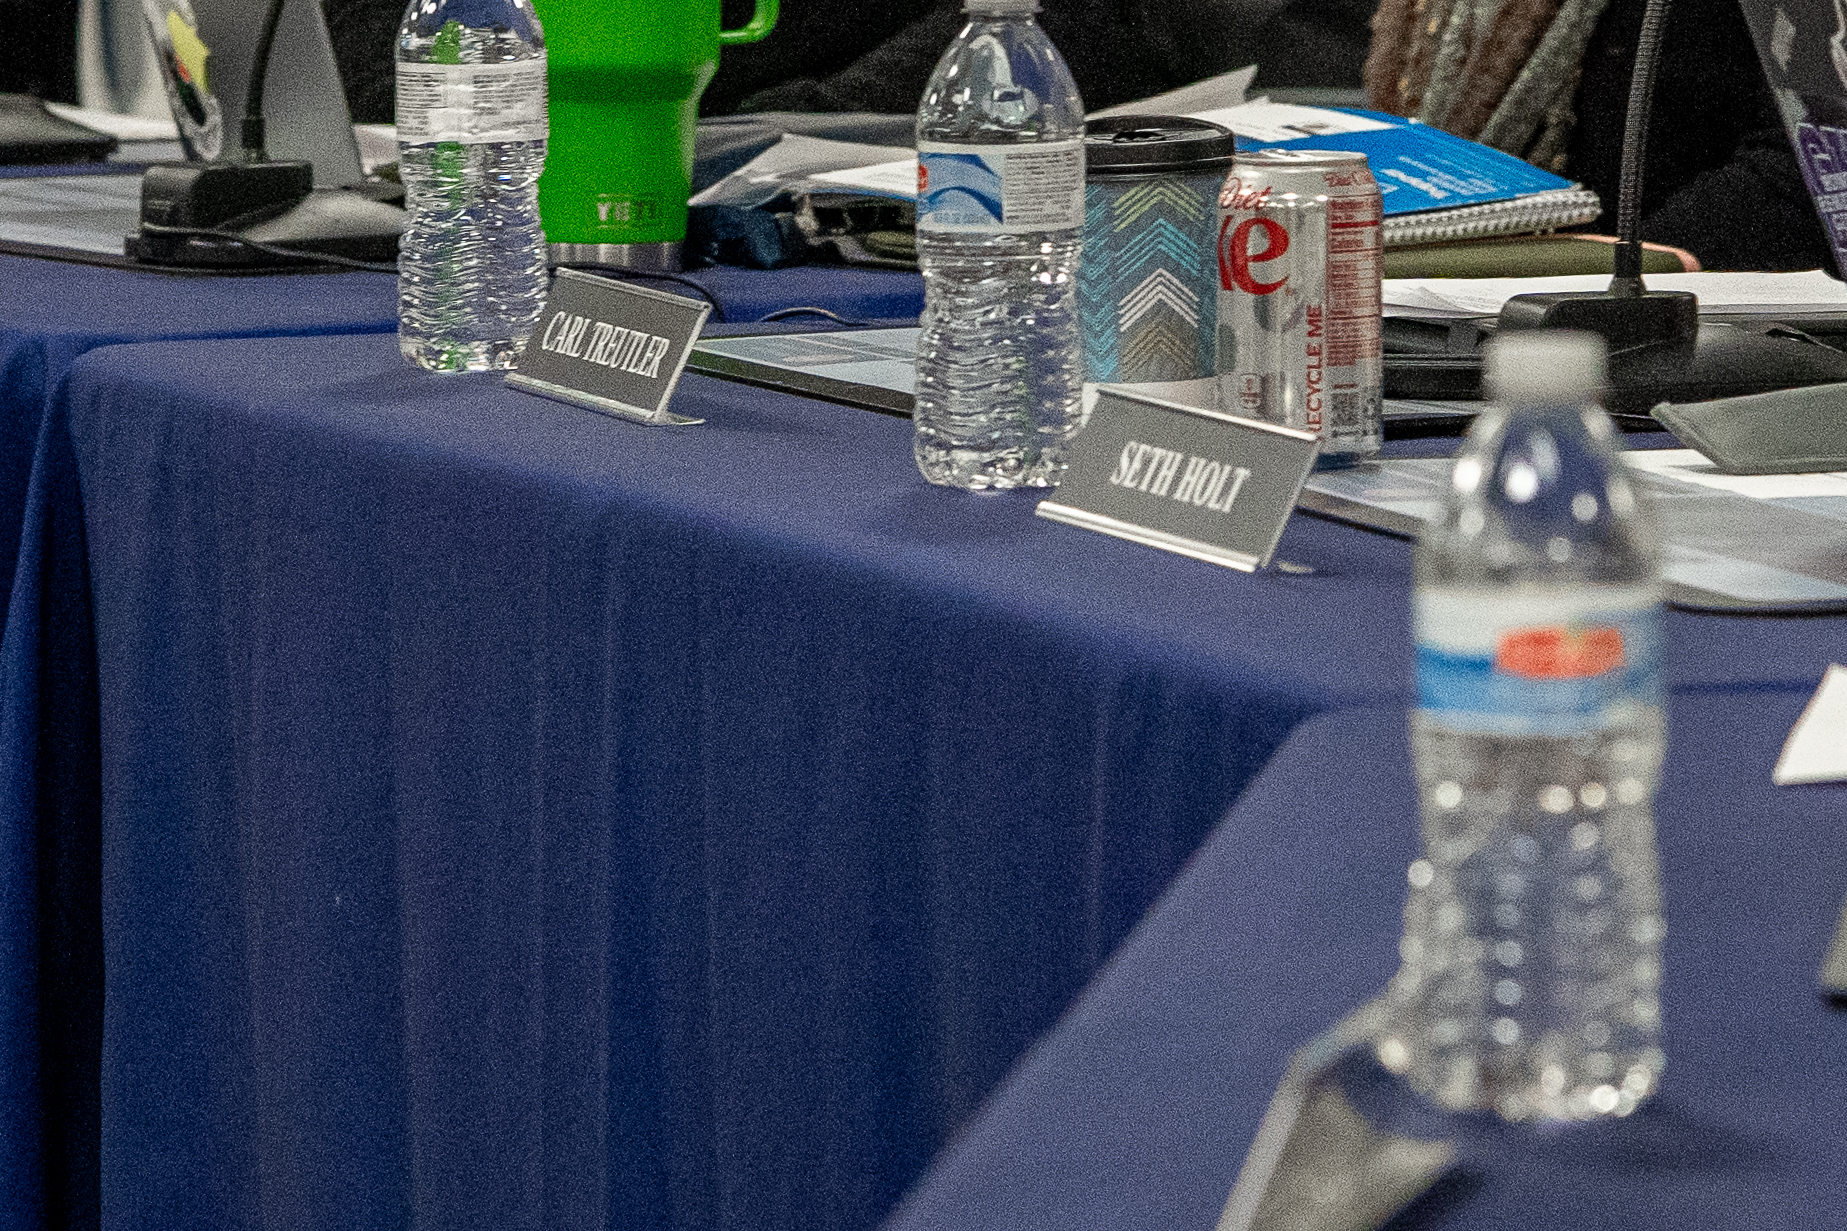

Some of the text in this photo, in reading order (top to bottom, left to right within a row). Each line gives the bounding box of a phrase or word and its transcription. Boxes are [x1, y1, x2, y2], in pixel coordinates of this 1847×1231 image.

[596, 200, 656, 222] YETI
[1219, 175, 1273, 212] Diet
[1305, 304, 1323, 339] ME
[541, 310, 671, 379] CARL TREUTLER
[1109, 440, 1253, 514] SETH HOLT
